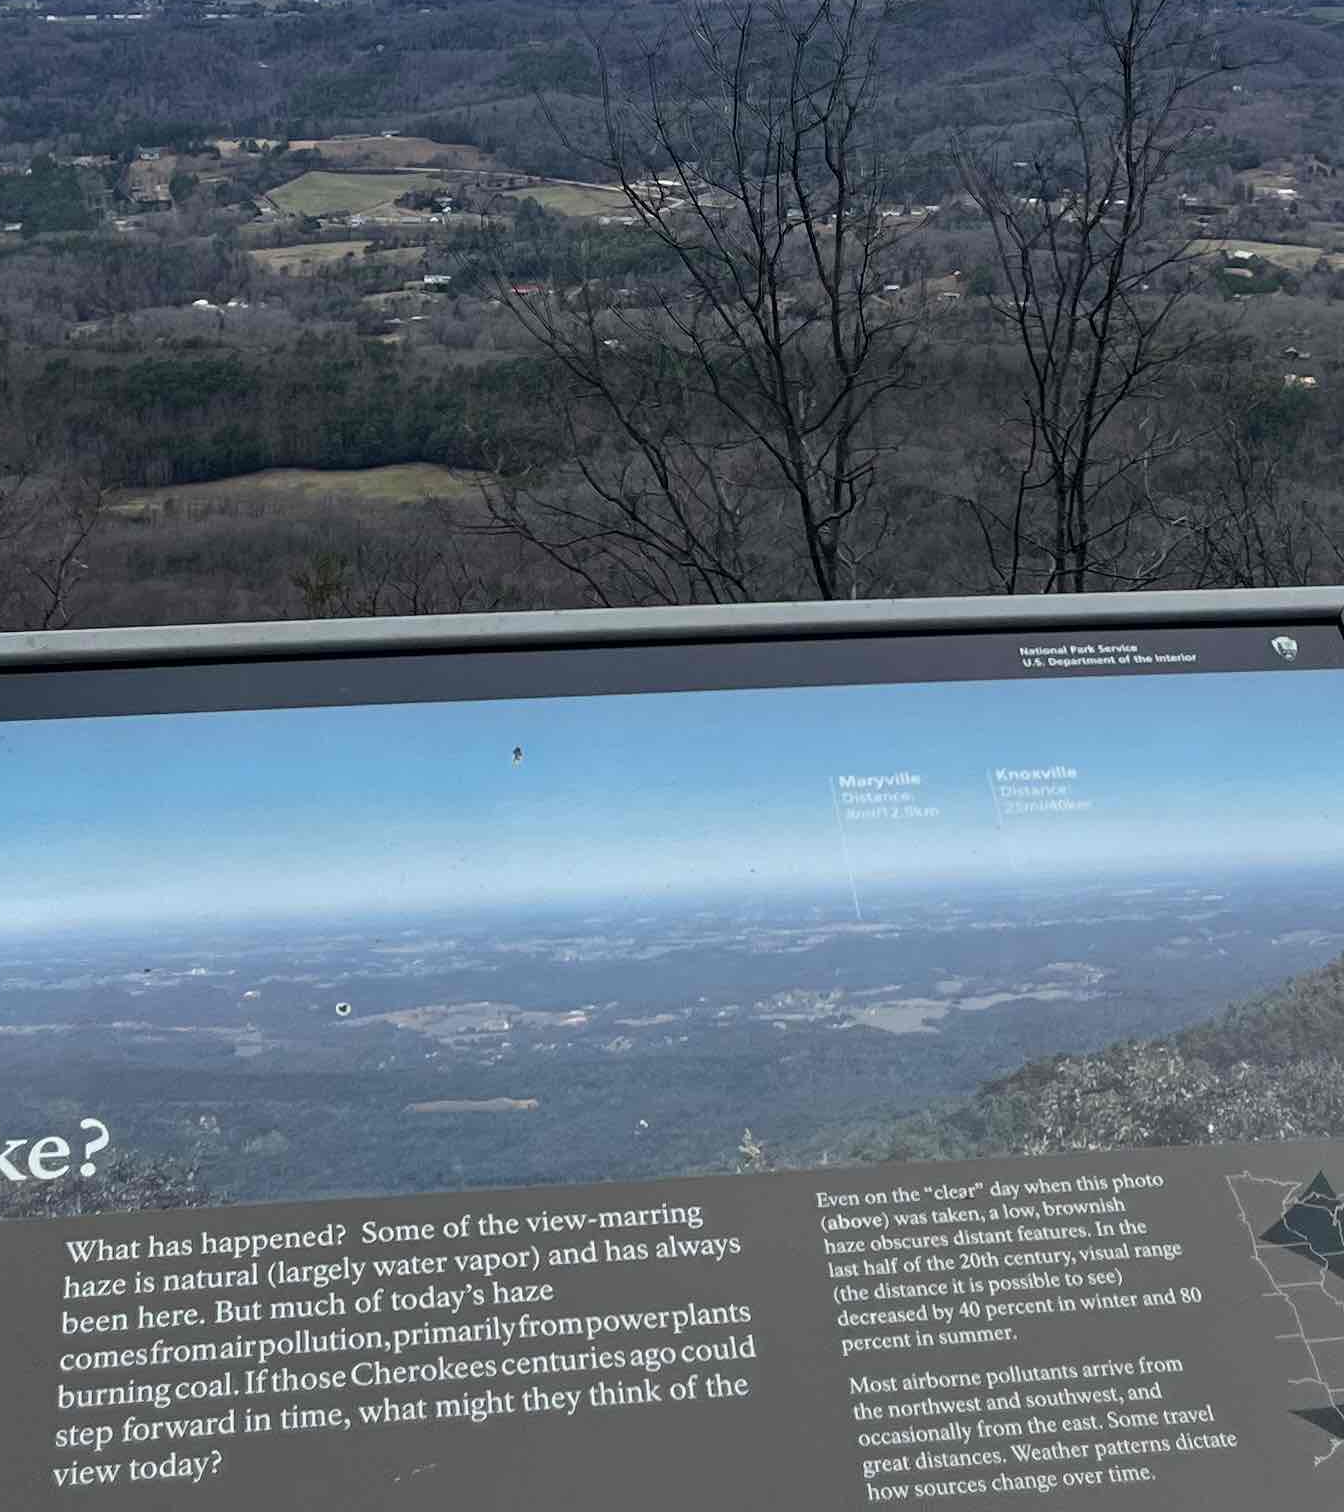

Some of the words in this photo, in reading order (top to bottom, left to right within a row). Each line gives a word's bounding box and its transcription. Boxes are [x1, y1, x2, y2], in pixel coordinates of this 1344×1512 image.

[1019, 646, 1067, 656] National
[1070, 645, 1096, 654] Park
[1098, 644, 1138, 653] Service
[1023, 657, 1044, 668] U.S.
[1048, 656, 1115, 667] Department
[1118, 654, 1130, 664] of
[1133, 654, 1153, 664] the
[1155, 653, 1198, 663] Interior
[839, 771, 921, 788] Maryville
[995, 766, 1077, 781] Knoxville
[65, 1238, 142, 1264] What
[146, 1234, 194, 1259] has
[200, 1222, 347, 1260] happened?
[361, 1220, 436, 1245] Some
[442, 1213, 472, 1239] of
[477, 1212, 520, 1237] the
[524, 1202, 705, 1233] view-marring
[822, 1237, 866, 1255] haze
[869, 1233, 950, 1252] obscures
[952, 1228, 1014, 1247] distant
[1016, 1224, 1092, 1242] features.
[1093, 1220, 1116, 1237] In
[1118, 1218, 1148, 1236] the
[62, 1274, 127, 1300] haze
[133, 1270, 156, 1295] is
[162, 1261, 259, 1293] natural
[267, 1255, 367, 1289] (largely
[371, 1255, 449, 1278] water
[453, 1244, 541, 1278] vapor)
[547, 1239, 600, 1267] and
[603, 1239, 650, 1263] has
[655, 1234, 742, 1263] always
[832, 1284, 870, 1305] (the
[873, 1281, 949, 1300] distance
[951, 1277, 966, 1295] it
[968, 1276, 985, 1294] is
[987, 1271, 1061, 1297] possible
[1063, 1272, 1084, 1288] to
[1086, 1266, 1124, 1287] see)
[836, 1303, 929, 1328] decreased
[931, 1303, 955, 1325] by
[958, 1300, 982, 1319] 40
[984, 1298, 1056, 1322] percent
[1057, 1295, 1077, 1313] in
[1079, 1292, 1139, 1311] winter
[1141, 1287, 1178, 1307] and
[1179, 1286, 1203, 1304] 80
[841, 1332, 913, 1358] percent
[914, 1329, 935, 1347] in
[937, 1327, 1018, 1345] summer.
[57, 1378, 173, 1410] burning
[174, 1371, 240, 1401] coal.
[243, 1367, 270, 1396] If
[270, 1367, 347, 1393] those
[350, 1355, 498, 1387] Cherokees
[500, 1345, 627, 1377] centuries
[629, 1346, 677, 1373] ago
[680, 1333, 758, 1364] could
[848, 1375, 899, 1395] Most
[901, 1370, 983, 1391] airborne
[985, 1364, 1079, 1390] pollutants
[1081, 1358, 1135, 1379] arrive
[1138, 1355, 1184, 1375] from
[54, 1424, 114, 1453] step
[121, 1407, 237, 1443] forward
[243, 1407, 273, 1434] in
[279, 1404, 352, 1432] time,
[357, 1396, 428, 1424] what
[434, 1389, 516, 1424] might
[521, 1385, 583, 1416] they
[588, 1377, 663, 1408] think
[669, 1373, 699, 1401] of
[704, 1372, 750, 1399] the
[852, 1401, 884, 1421] the
[887, 1396, 983, 1419] northwest
[985, 1390, 1022, 1411] and
[1025, 1386, 1125, 1409] southwest,
[1126, 1380, 1164, 1401] and
[857, 1421, 972, 1448] occasionally
[976, 1418, 1023, 1439] from
[1026, 1415, 1058, 1435] the
[1061, 1415, 1104, 1432] east.
[1106, 1410, 1160, 1430] Some
[1162, 1403, 1216, 1425] travel
[52, 1459, 122, 1488] view
[128, 1448, 223, 1484] today?
[862, 1455, 912, 1480] great
[914, 1450, 1008, 1471] distances.
[1009, 1440, 1090, 1463] Weather
[1093, 1438, 1172, 1462] patterns
[1174, 1432, 1238, 1451] dictate
[865, 1482, 910, 1502] how
[913, 1478, 988, 1498] sources
[990, 1471, 1059, 1494] change
[1062, 1470, 1104, 1487] over
[1107, 1464, 1157, 1483] time.
